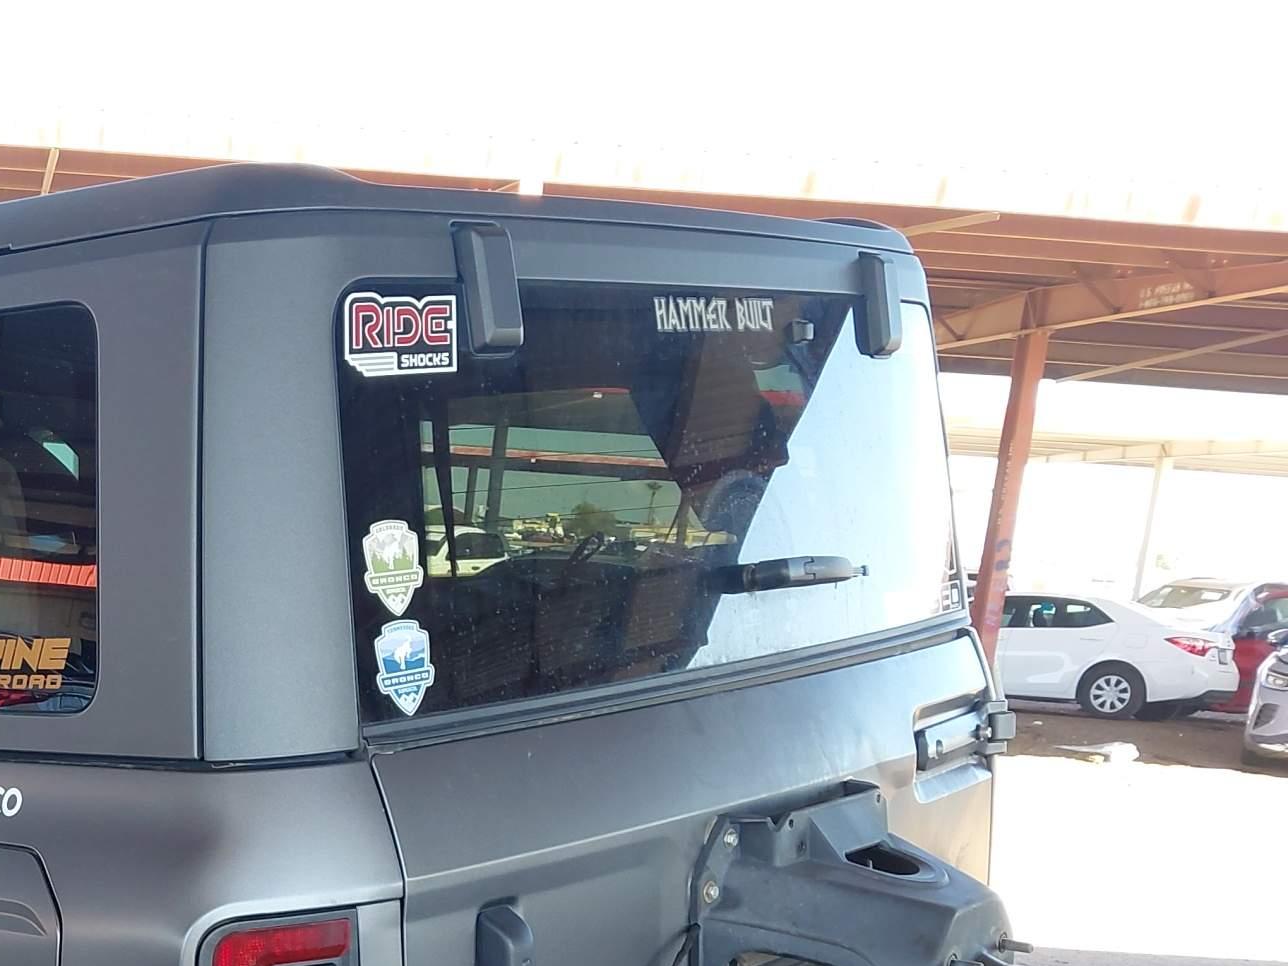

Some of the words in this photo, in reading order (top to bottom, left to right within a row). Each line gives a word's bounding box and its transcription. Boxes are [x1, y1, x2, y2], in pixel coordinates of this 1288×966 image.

[353, 302, 450, 349] RIDE
[653, 295, 732, 332] HAMMER
[734, 297, 774, 332] BUILT
[400, 352, 450, 368] SHOCKS
